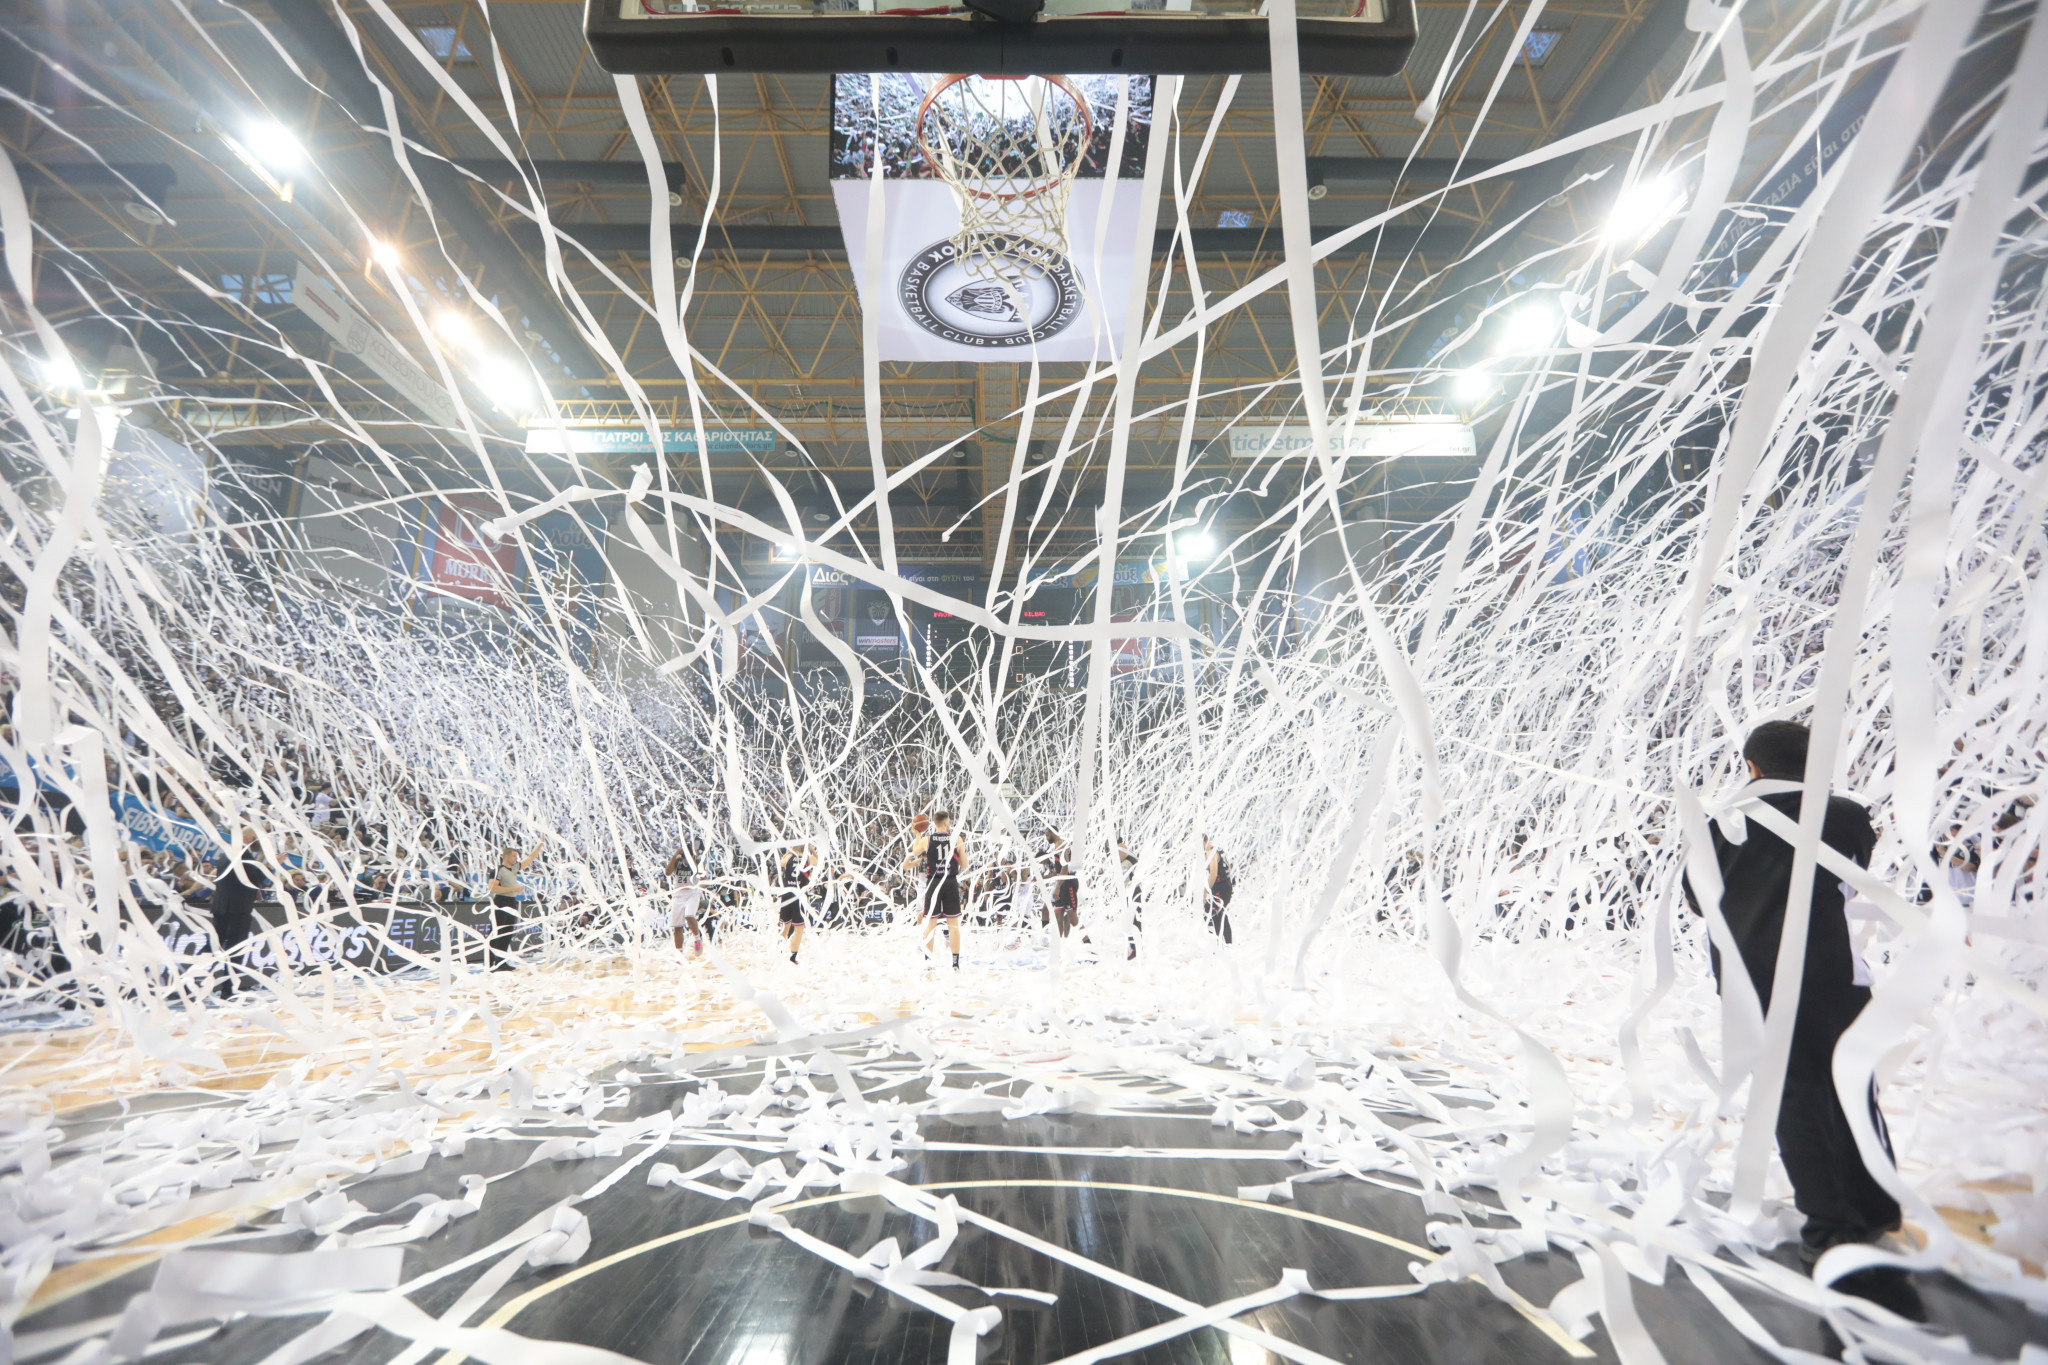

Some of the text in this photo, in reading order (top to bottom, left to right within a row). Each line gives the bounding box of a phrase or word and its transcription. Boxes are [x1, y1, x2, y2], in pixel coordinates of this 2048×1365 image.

[1728, 172, 1803, 243] ΠΡΟΤΑΣΙΑ
[904, 262, 940, 331] BASKETBALL
[943, 330, 984, 345] CLUB
[1233, 432, 1372, 451] ticketmster
[444, 558, 502, 584] MORR
